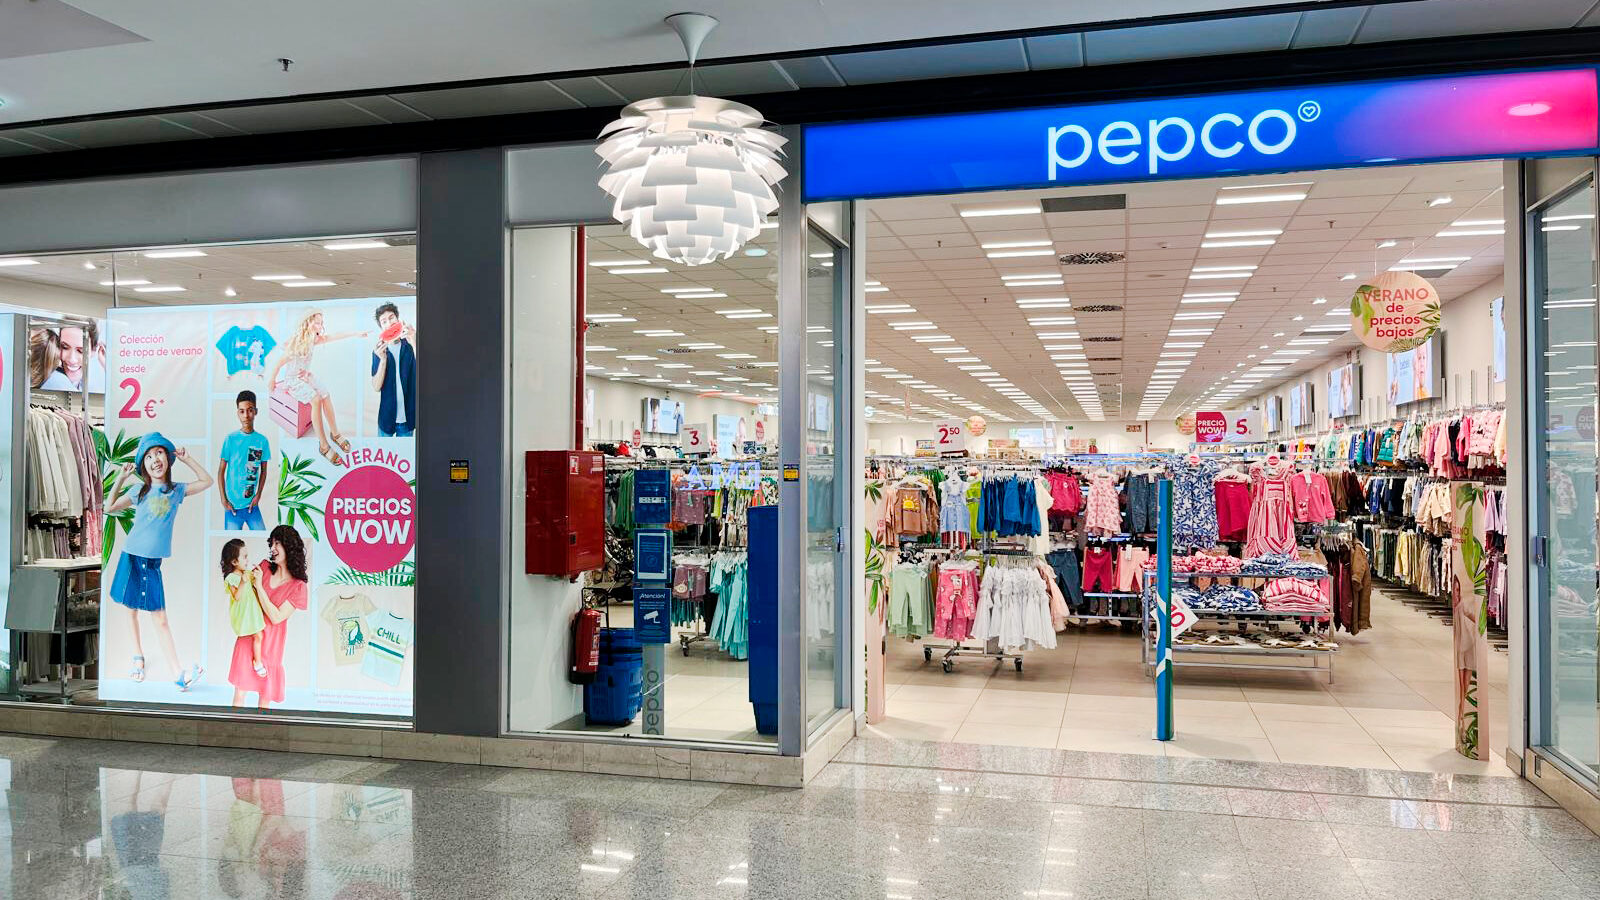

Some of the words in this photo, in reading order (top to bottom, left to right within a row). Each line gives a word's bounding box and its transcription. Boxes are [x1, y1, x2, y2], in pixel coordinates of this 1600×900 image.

[1048, 109, 1297, 180] pepco
[1363, 288, 1429, 301] VERANO
[1386, 303, 1404, 313] de
[1370, 315, 1421, 327] precios
[119, 334, 164, 344] Colección
[1376, 327, 1414, 340] bajos
[119, 348, 131, 357] de
[133, 349, 155, 358] ropa
[157, 347, 168, 356] de
[171, 347, 203, 356] verano
[119, 364, 146, 373] desde
[340, 447, 411, 474] VERANO
[332, 498, 412, 515] PRECIOS
[333, 518, 412, 544] WOW
[376, 627, 401, 645] CHILL
